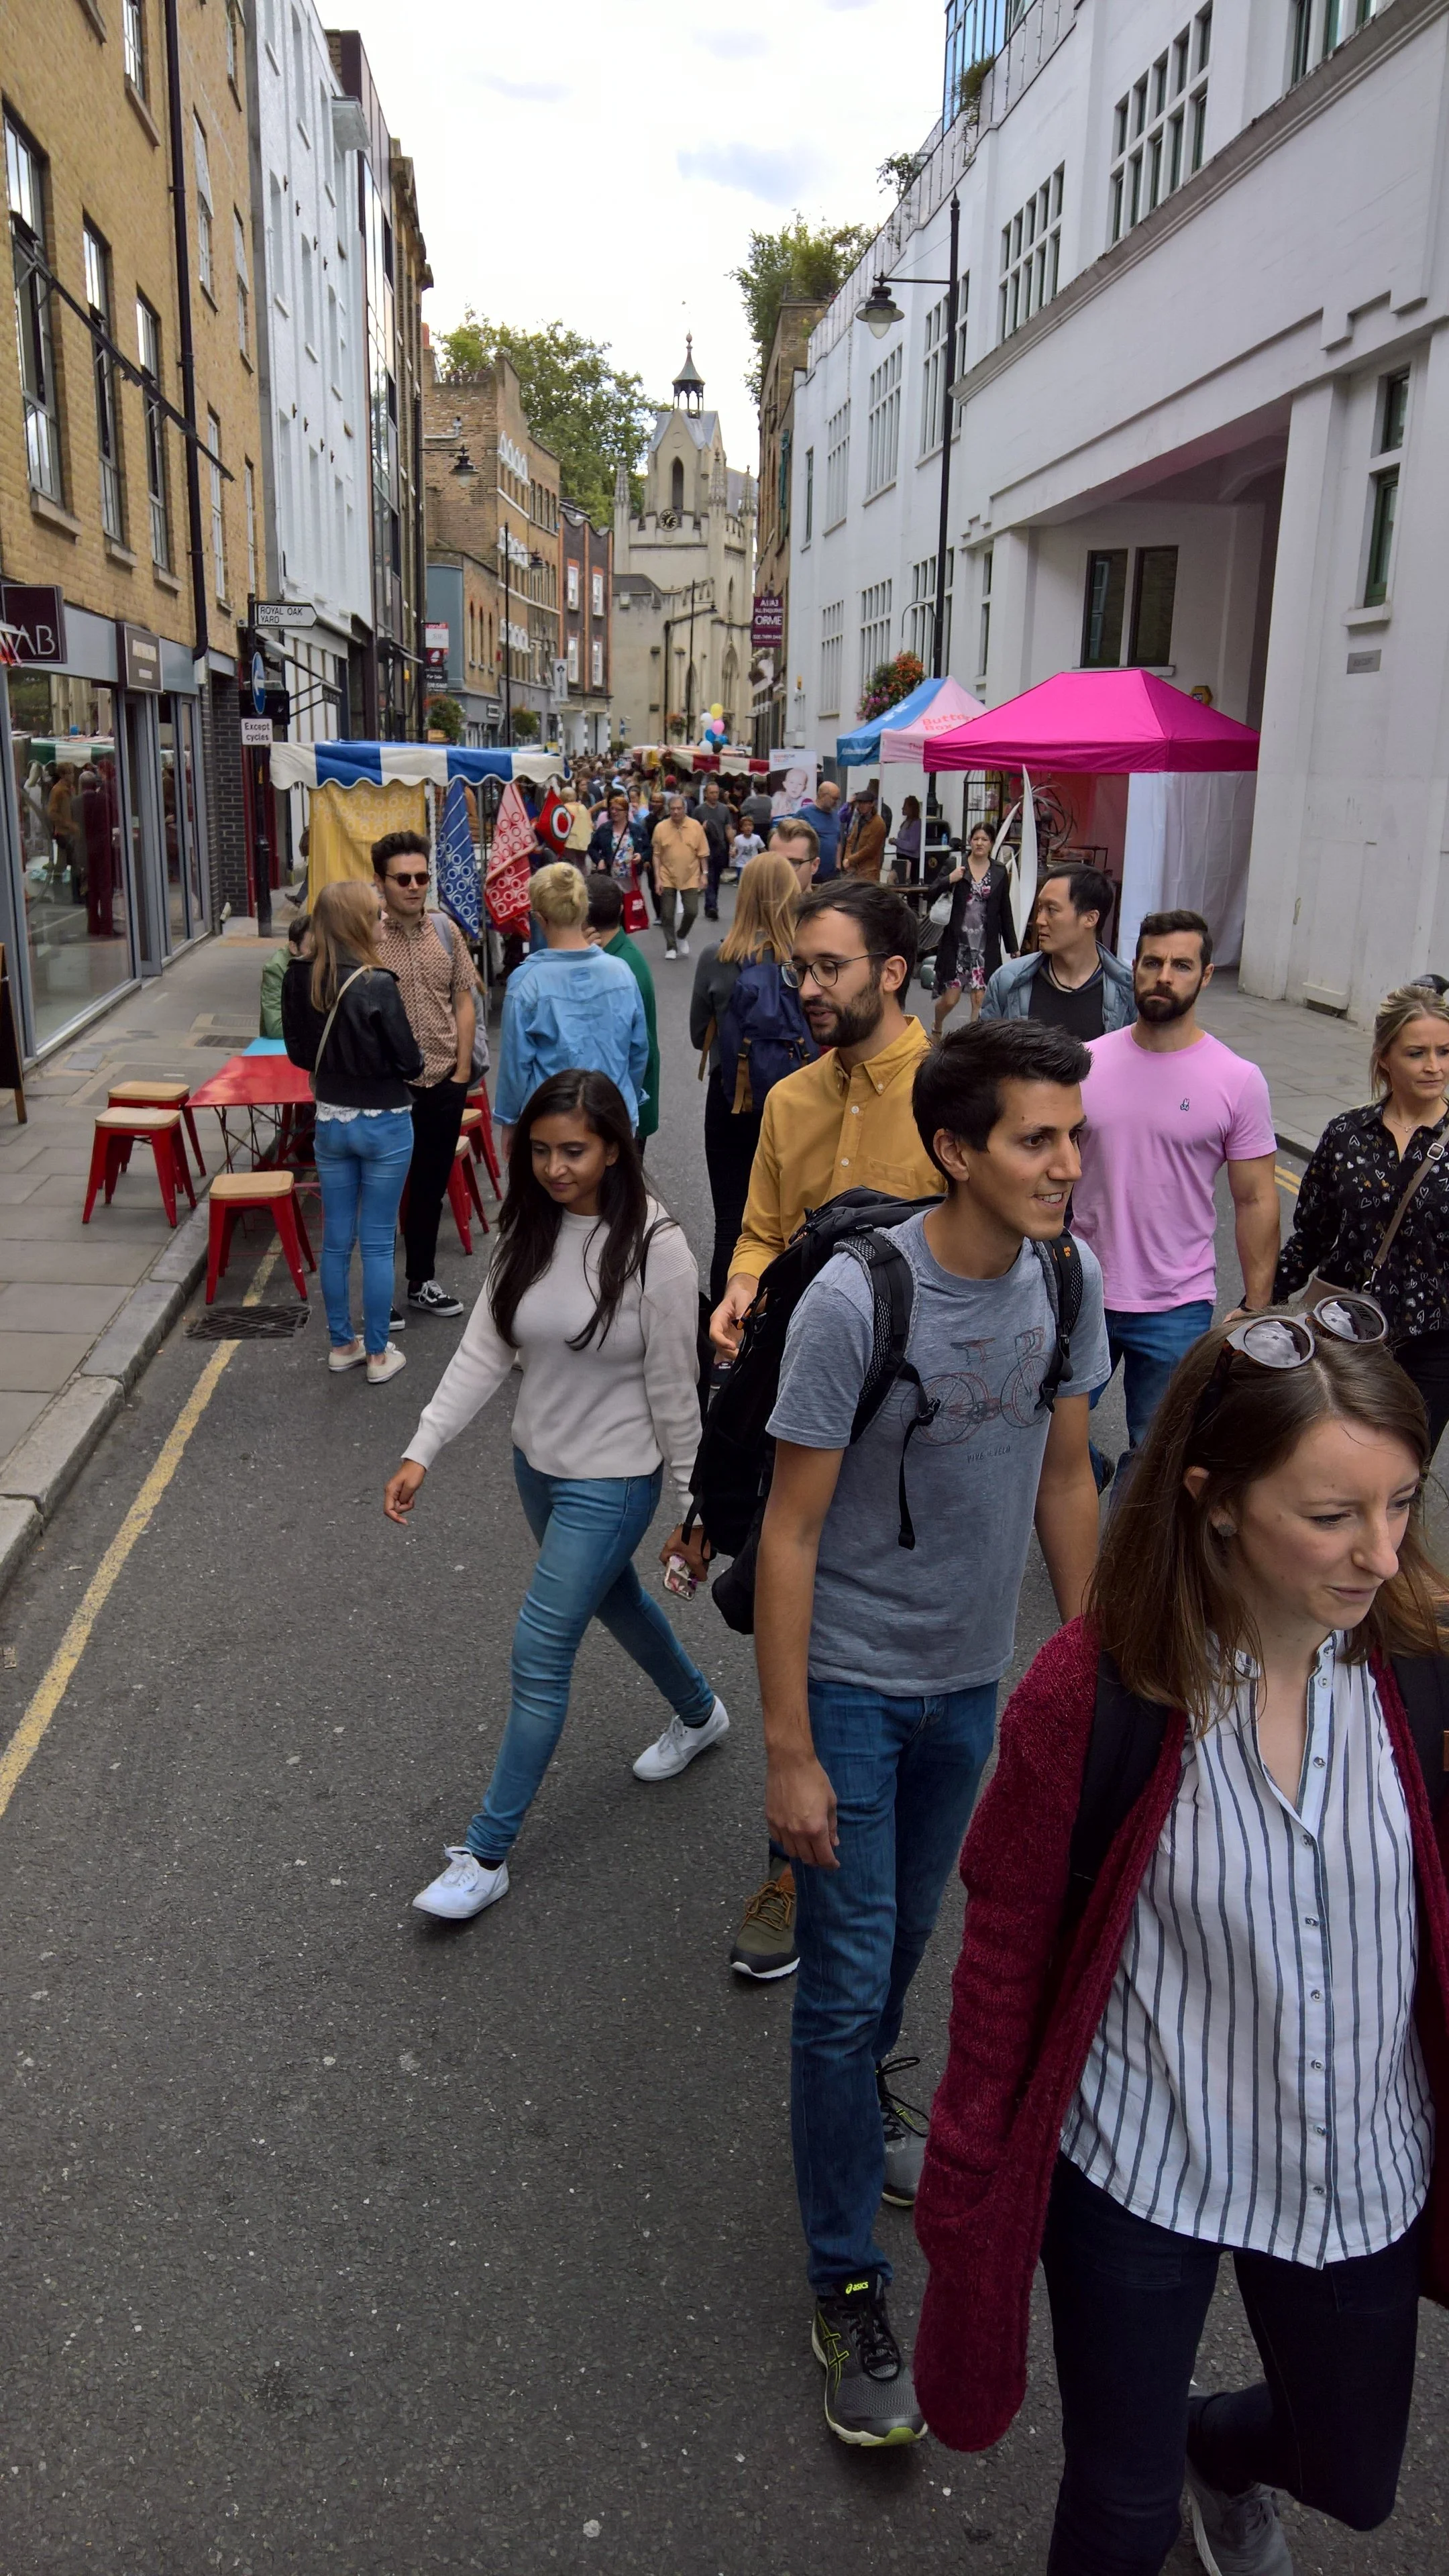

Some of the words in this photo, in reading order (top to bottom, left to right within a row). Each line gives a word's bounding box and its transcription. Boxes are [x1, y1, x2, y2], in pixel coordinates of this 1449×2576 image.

[260, 606, 284, 615] ROYAL
[286, 607, 303, 616] OAK
[260, 615, 280, 624] YARD
[244, 722, 270, 732] Except
[246, 733, 269, 742] cycles
[853, 2282, 869, 2291] asics
